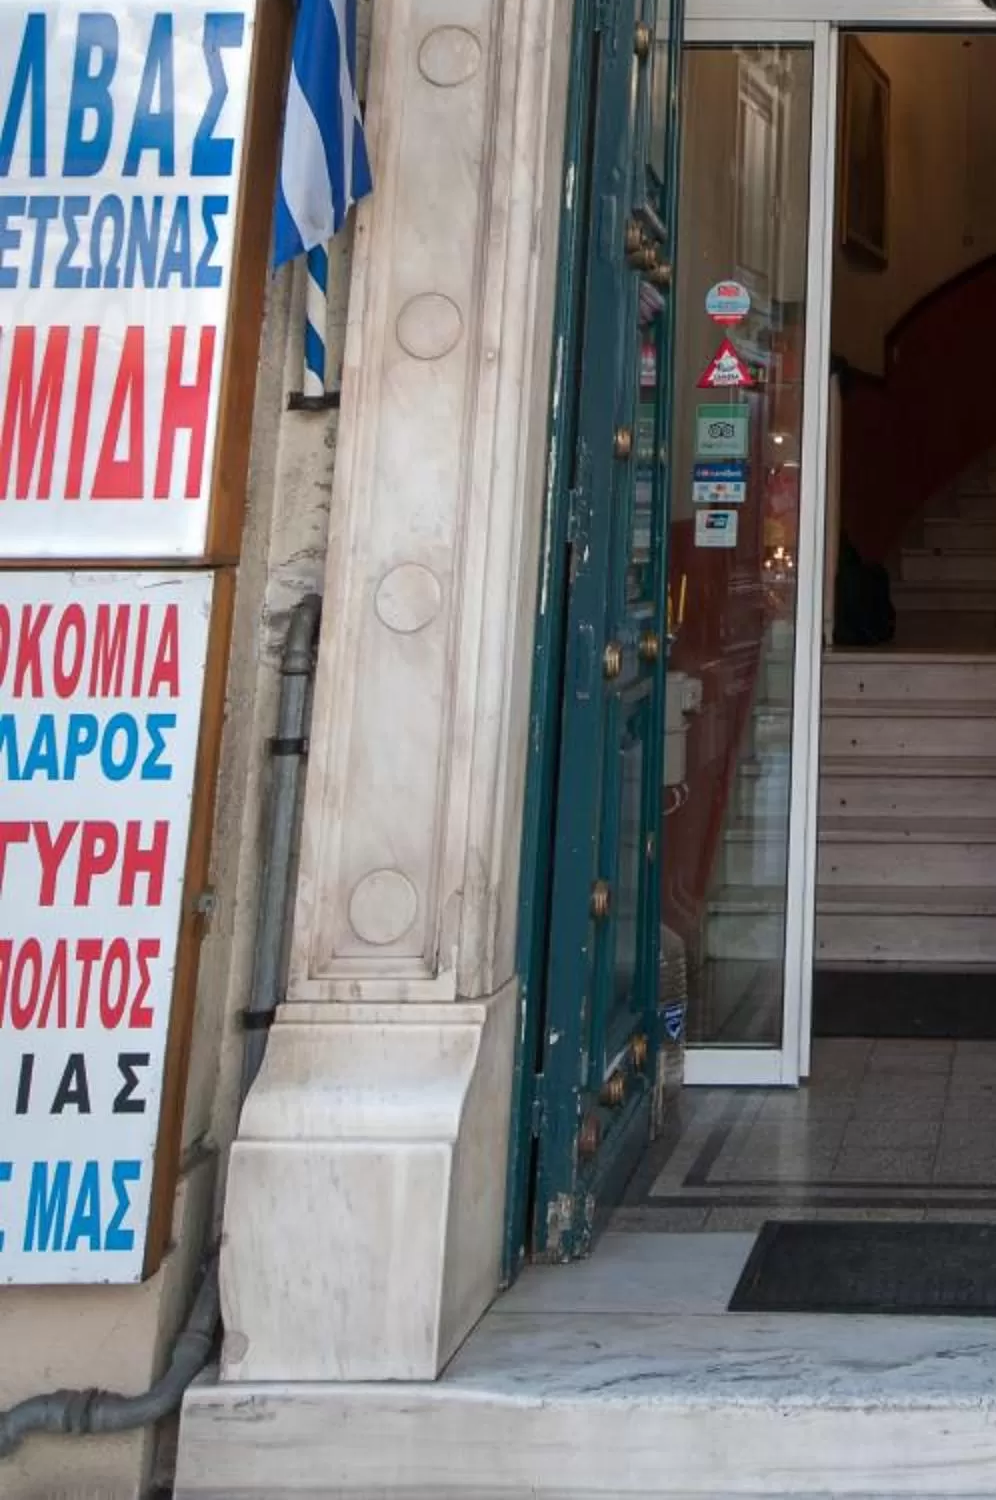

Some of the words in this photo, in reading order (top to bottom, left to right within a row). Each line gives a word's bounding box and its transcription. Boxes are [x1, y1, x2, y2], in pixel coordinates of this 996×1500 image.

[0, 12, 245, 176] ΛΒΑΣ
[0, 193, 229, 289] ΕΤΣΩΝΑΣ
[0, 325, 216, 500] ΜΙΔΗ
[23, 1160, 141, 1252] ΜΑΣ
